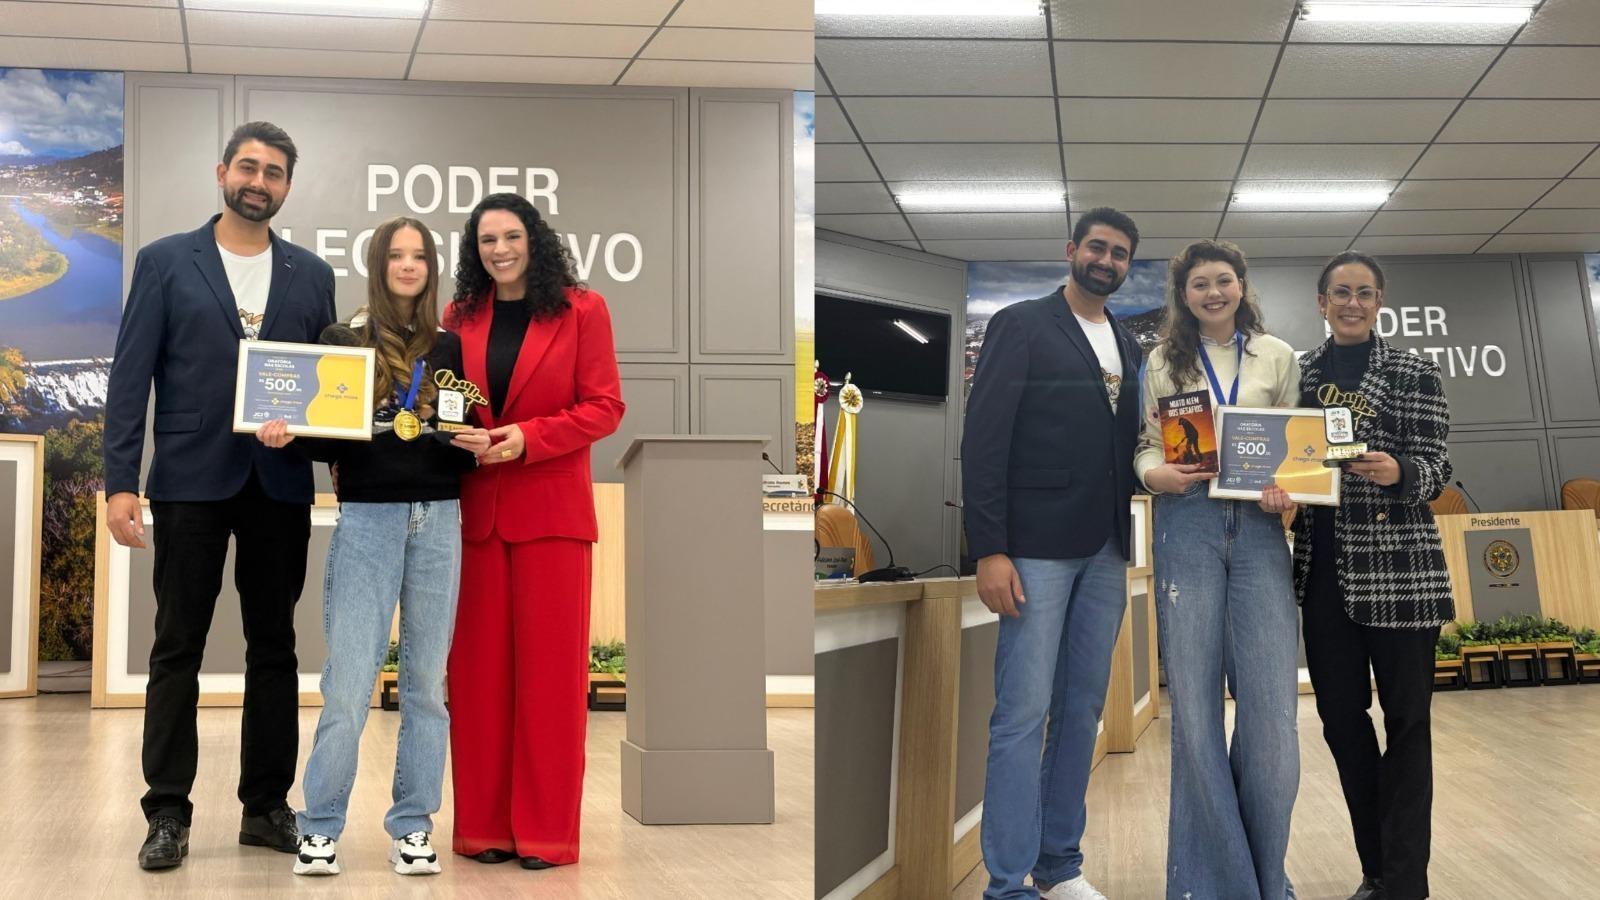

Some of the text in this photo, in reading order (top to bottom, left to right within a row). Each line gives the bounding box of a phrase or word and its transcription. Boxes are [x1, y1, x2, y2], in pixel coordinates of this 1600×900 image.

[367, 164, 559, 215] PODER
[1325, 306, 1448, 338] DER
[264, 377, 297, 392] 500
[1237, 442, 1266, 456] 500
[763, 500, 816, 512] ecretári
[1470, 516, 1521, 527] Presidente
